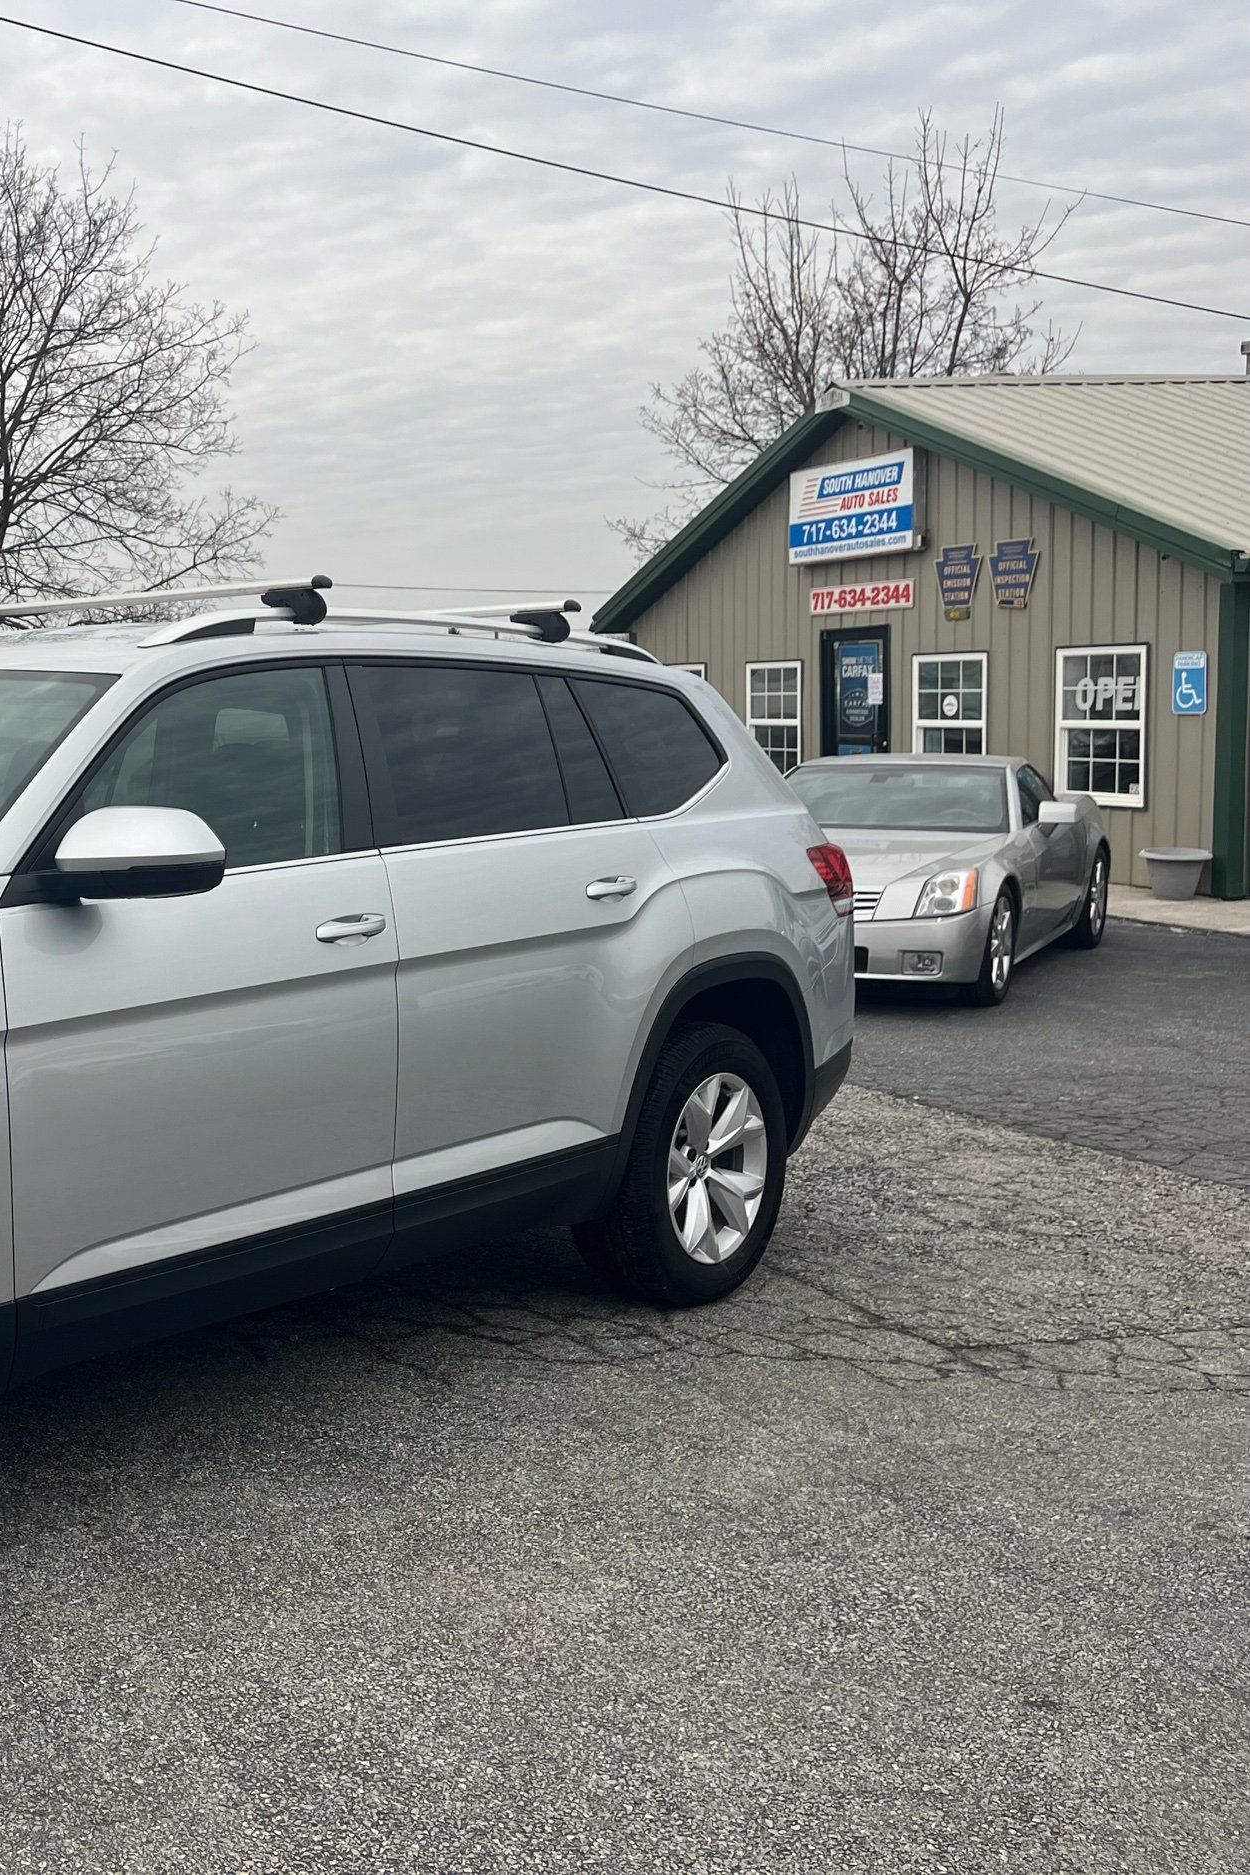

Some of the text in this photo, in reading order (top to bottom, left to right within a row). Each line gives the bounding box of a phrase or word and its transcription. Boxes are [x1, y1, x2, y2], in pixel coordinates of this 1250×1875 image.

[823, 466, 899, 495] SOUTH HANOVER
[839, 488, 899, 512] AUTO SALES
[802, 511, 898, 543] 717-634-2344
[794, 534, 907, 559] southhanoverautosales.com
[943, 565, 971, 576] OFFICIAL
[997, 560, 1027, 571] OFFICIAL
[994, 574, 1030, 585] INSPECTION
[812, 583, 911, 611] 717-634-2344
[944, 591, 969, 601] STATION
[998, 588, 1025, 598] STATION
